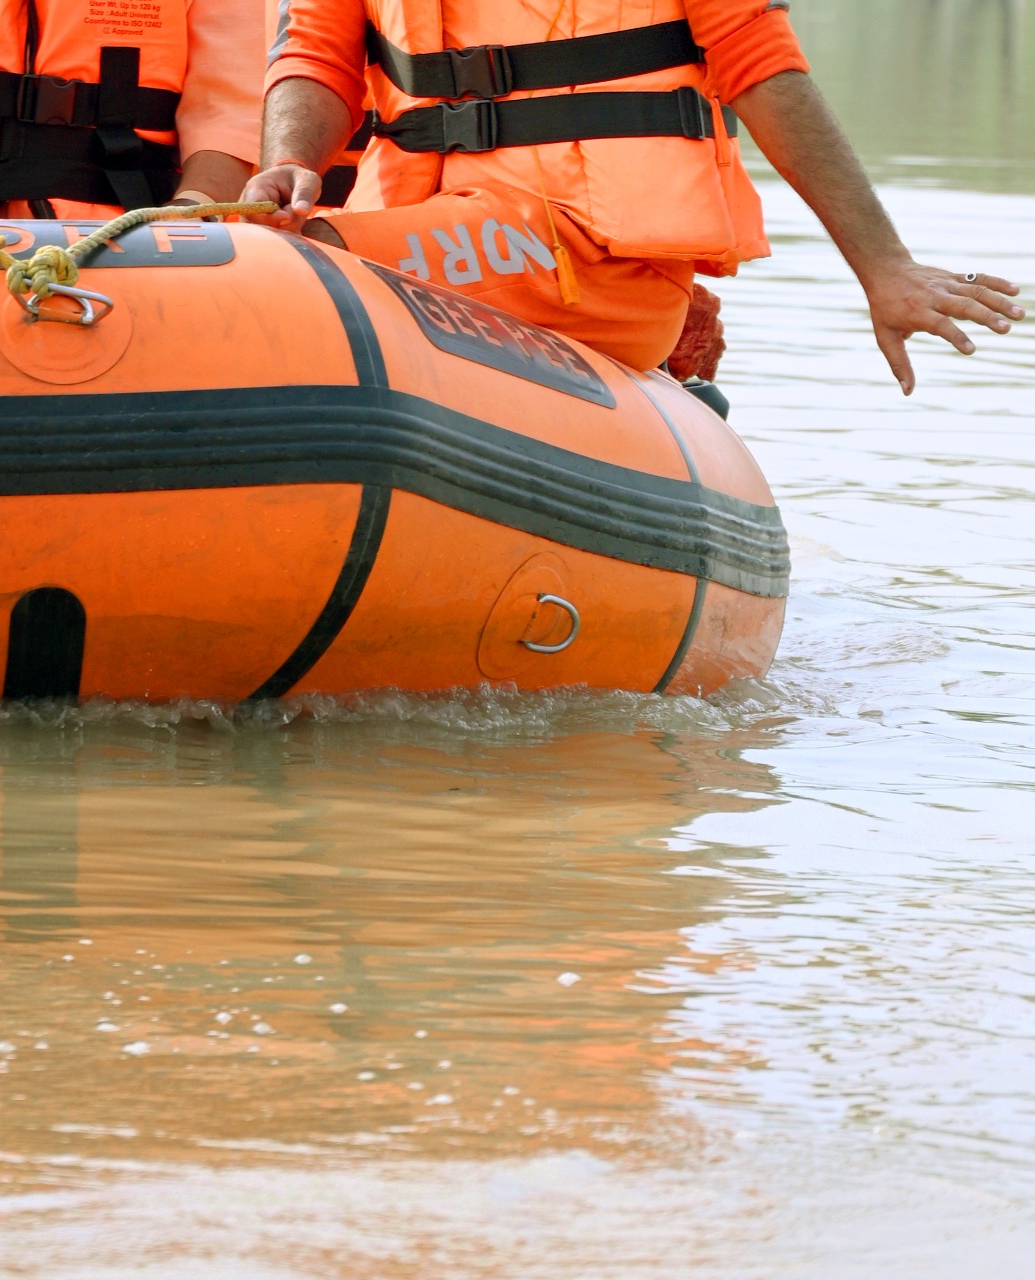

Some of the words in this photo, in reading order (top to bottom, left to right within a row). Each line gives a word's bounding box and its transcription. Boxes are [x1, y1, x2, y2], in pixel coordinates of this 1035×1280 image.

[120, 2, 130, 10] Up
[152, 5, 161, 13] kg
[111, 27, 144, 35] Approved
[397, 218, 558, 285] NDRF
[400, 281, 502, 347] GEE
[493, 315, 591, 379] PEE
